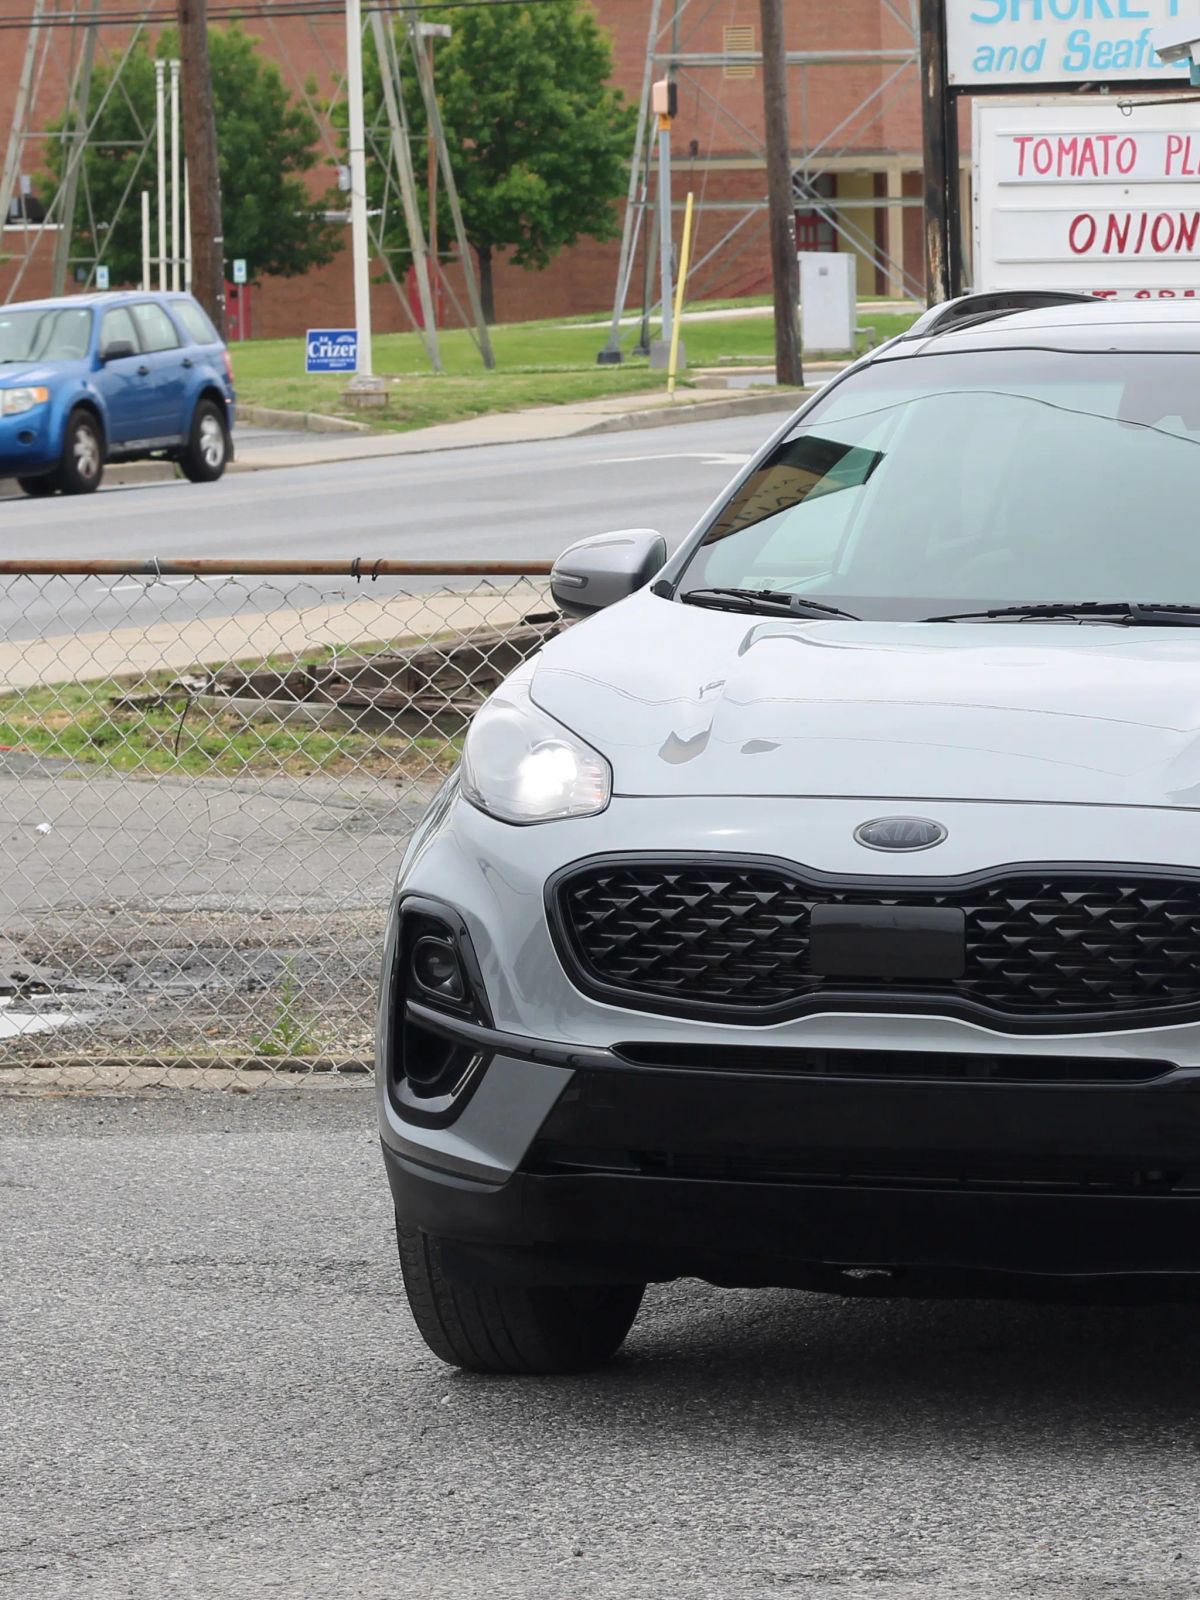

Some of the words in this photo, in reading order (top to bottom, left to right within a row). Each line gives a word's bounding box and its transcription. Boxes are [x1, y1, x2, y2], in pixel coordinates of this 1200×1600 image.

[972, 38, 1047, 73] and
[1013, 135, 1137, 176] TOMATO
[1068, 211, 1200, 254] ONION
[308, 340, 357, 358] Crizer
